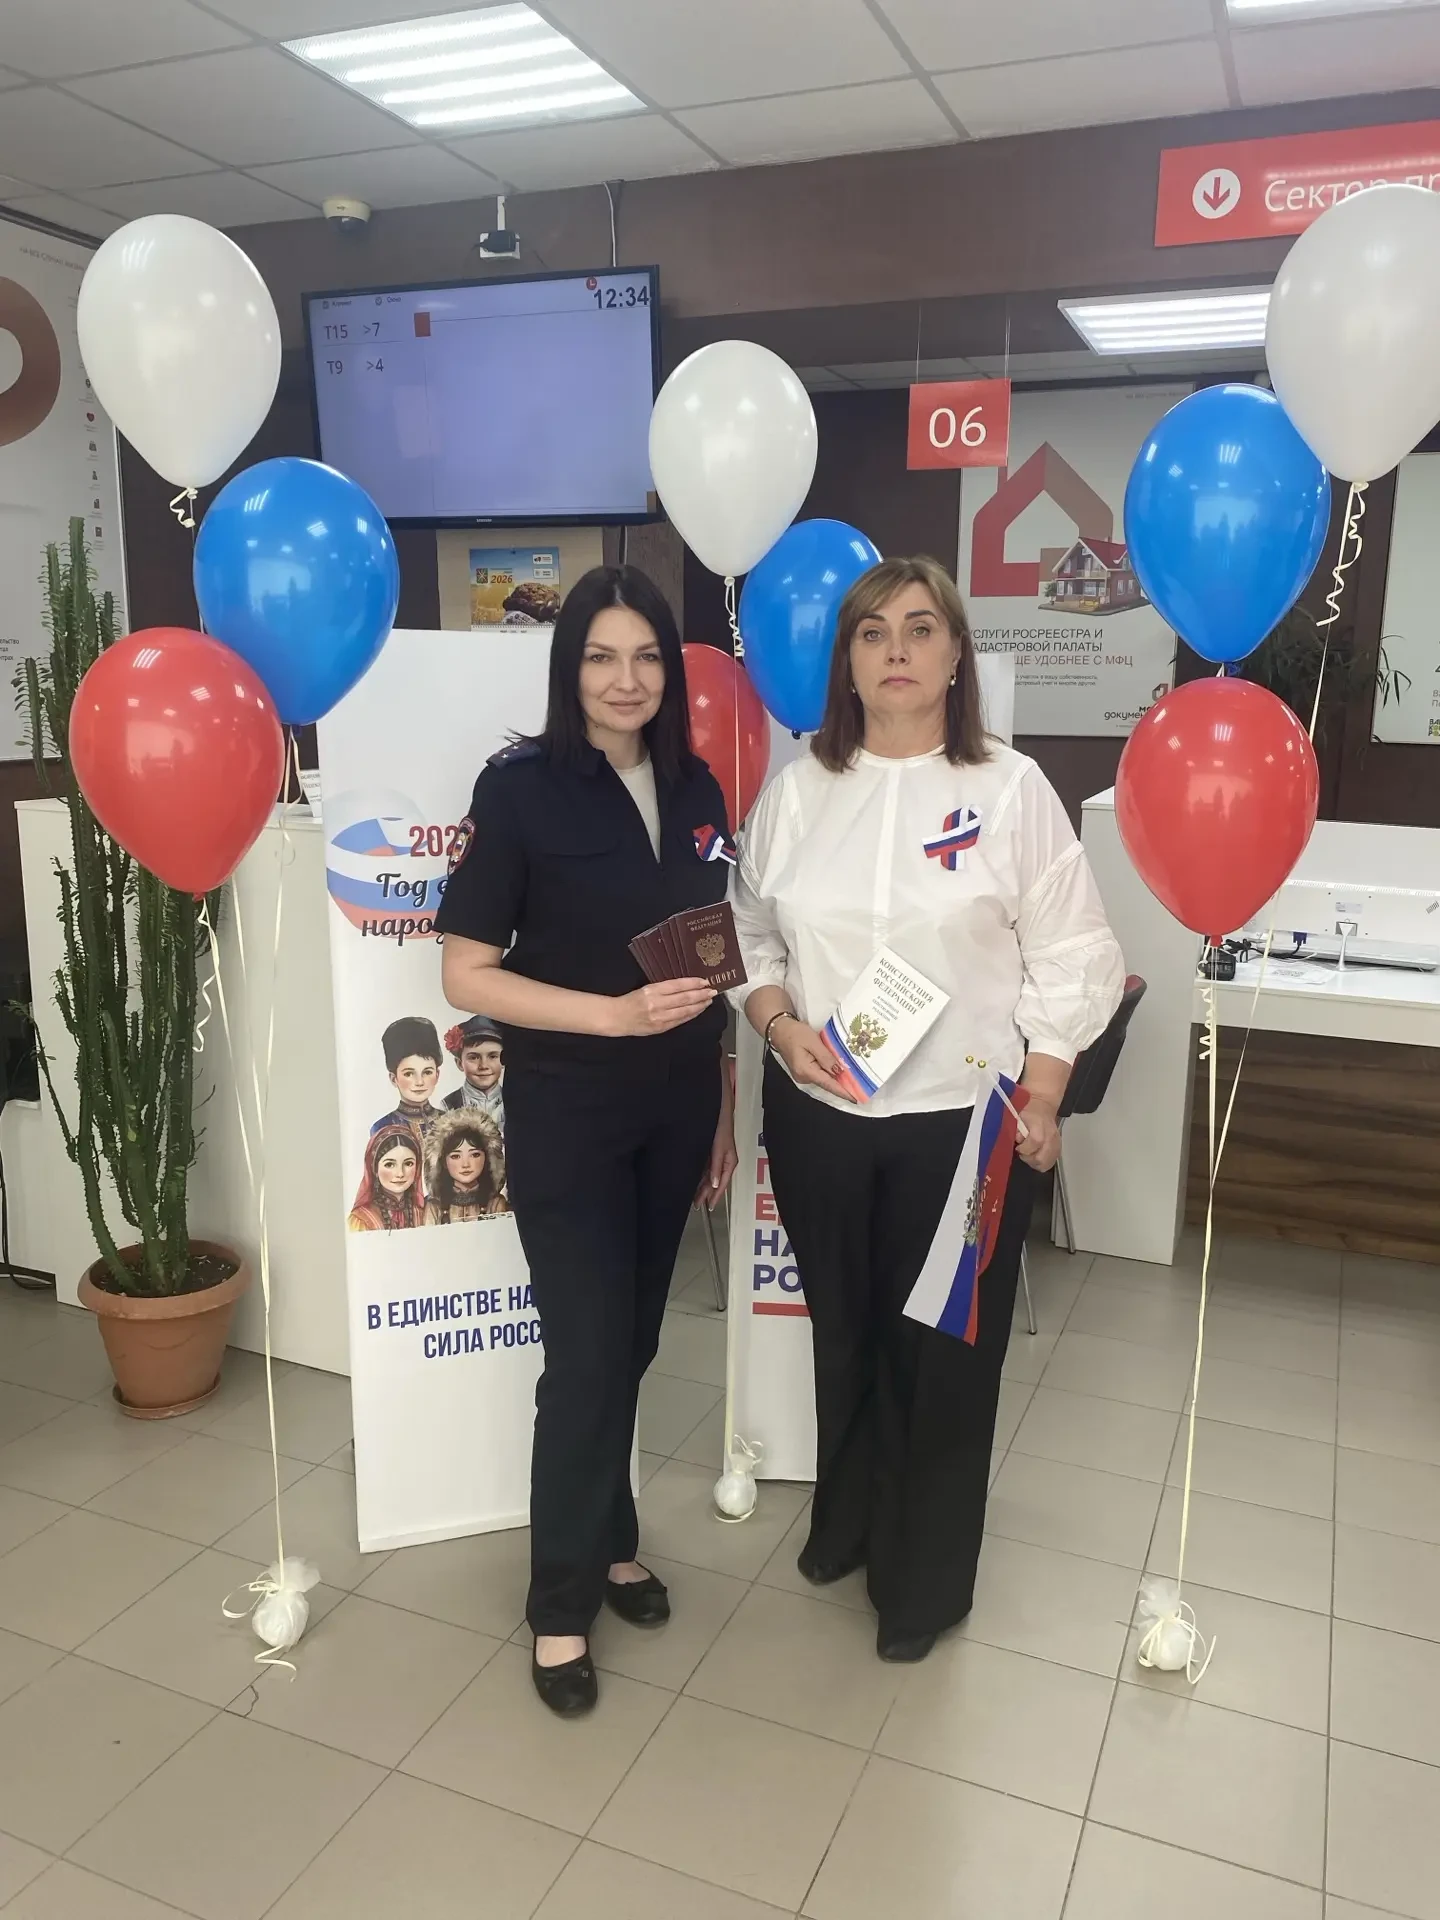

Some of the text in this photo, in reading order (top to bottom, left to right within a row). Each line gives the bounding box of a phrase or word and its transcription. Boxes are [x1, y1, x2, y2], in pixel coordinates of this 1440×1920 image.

[593, 286, 650, 309] 12:34
[929, 406, 987, 448] 06
[491, 574, 513, 584] 2026
[1012, 628, 1091, 639] РОСРЕЕСТРА
[1094, 628, 1103, 638] И
[1053, 641, 1102, 653] ПАЛАТЫ
[1034, 655, 1090, 667] УДОБНЕЕ
[1093, 655, 1102, 665] С
[1105, 655, 1133, 667] МФЦ
[375, 872, 428, 908] Год
[873, 977, 918, 1016] ФЕДЕРАЦИИ
[875, 967, 926, 1010] РОССИЙСКОЙ
[879, 957, 934, 1004] КОНСТИТУЦИЯ
[367, 1304, 382, 1330] В
[388, 1288, 502, 1329] ЕДИНСТВЕ
[424, 1328, 484, 1359] СИЛА
